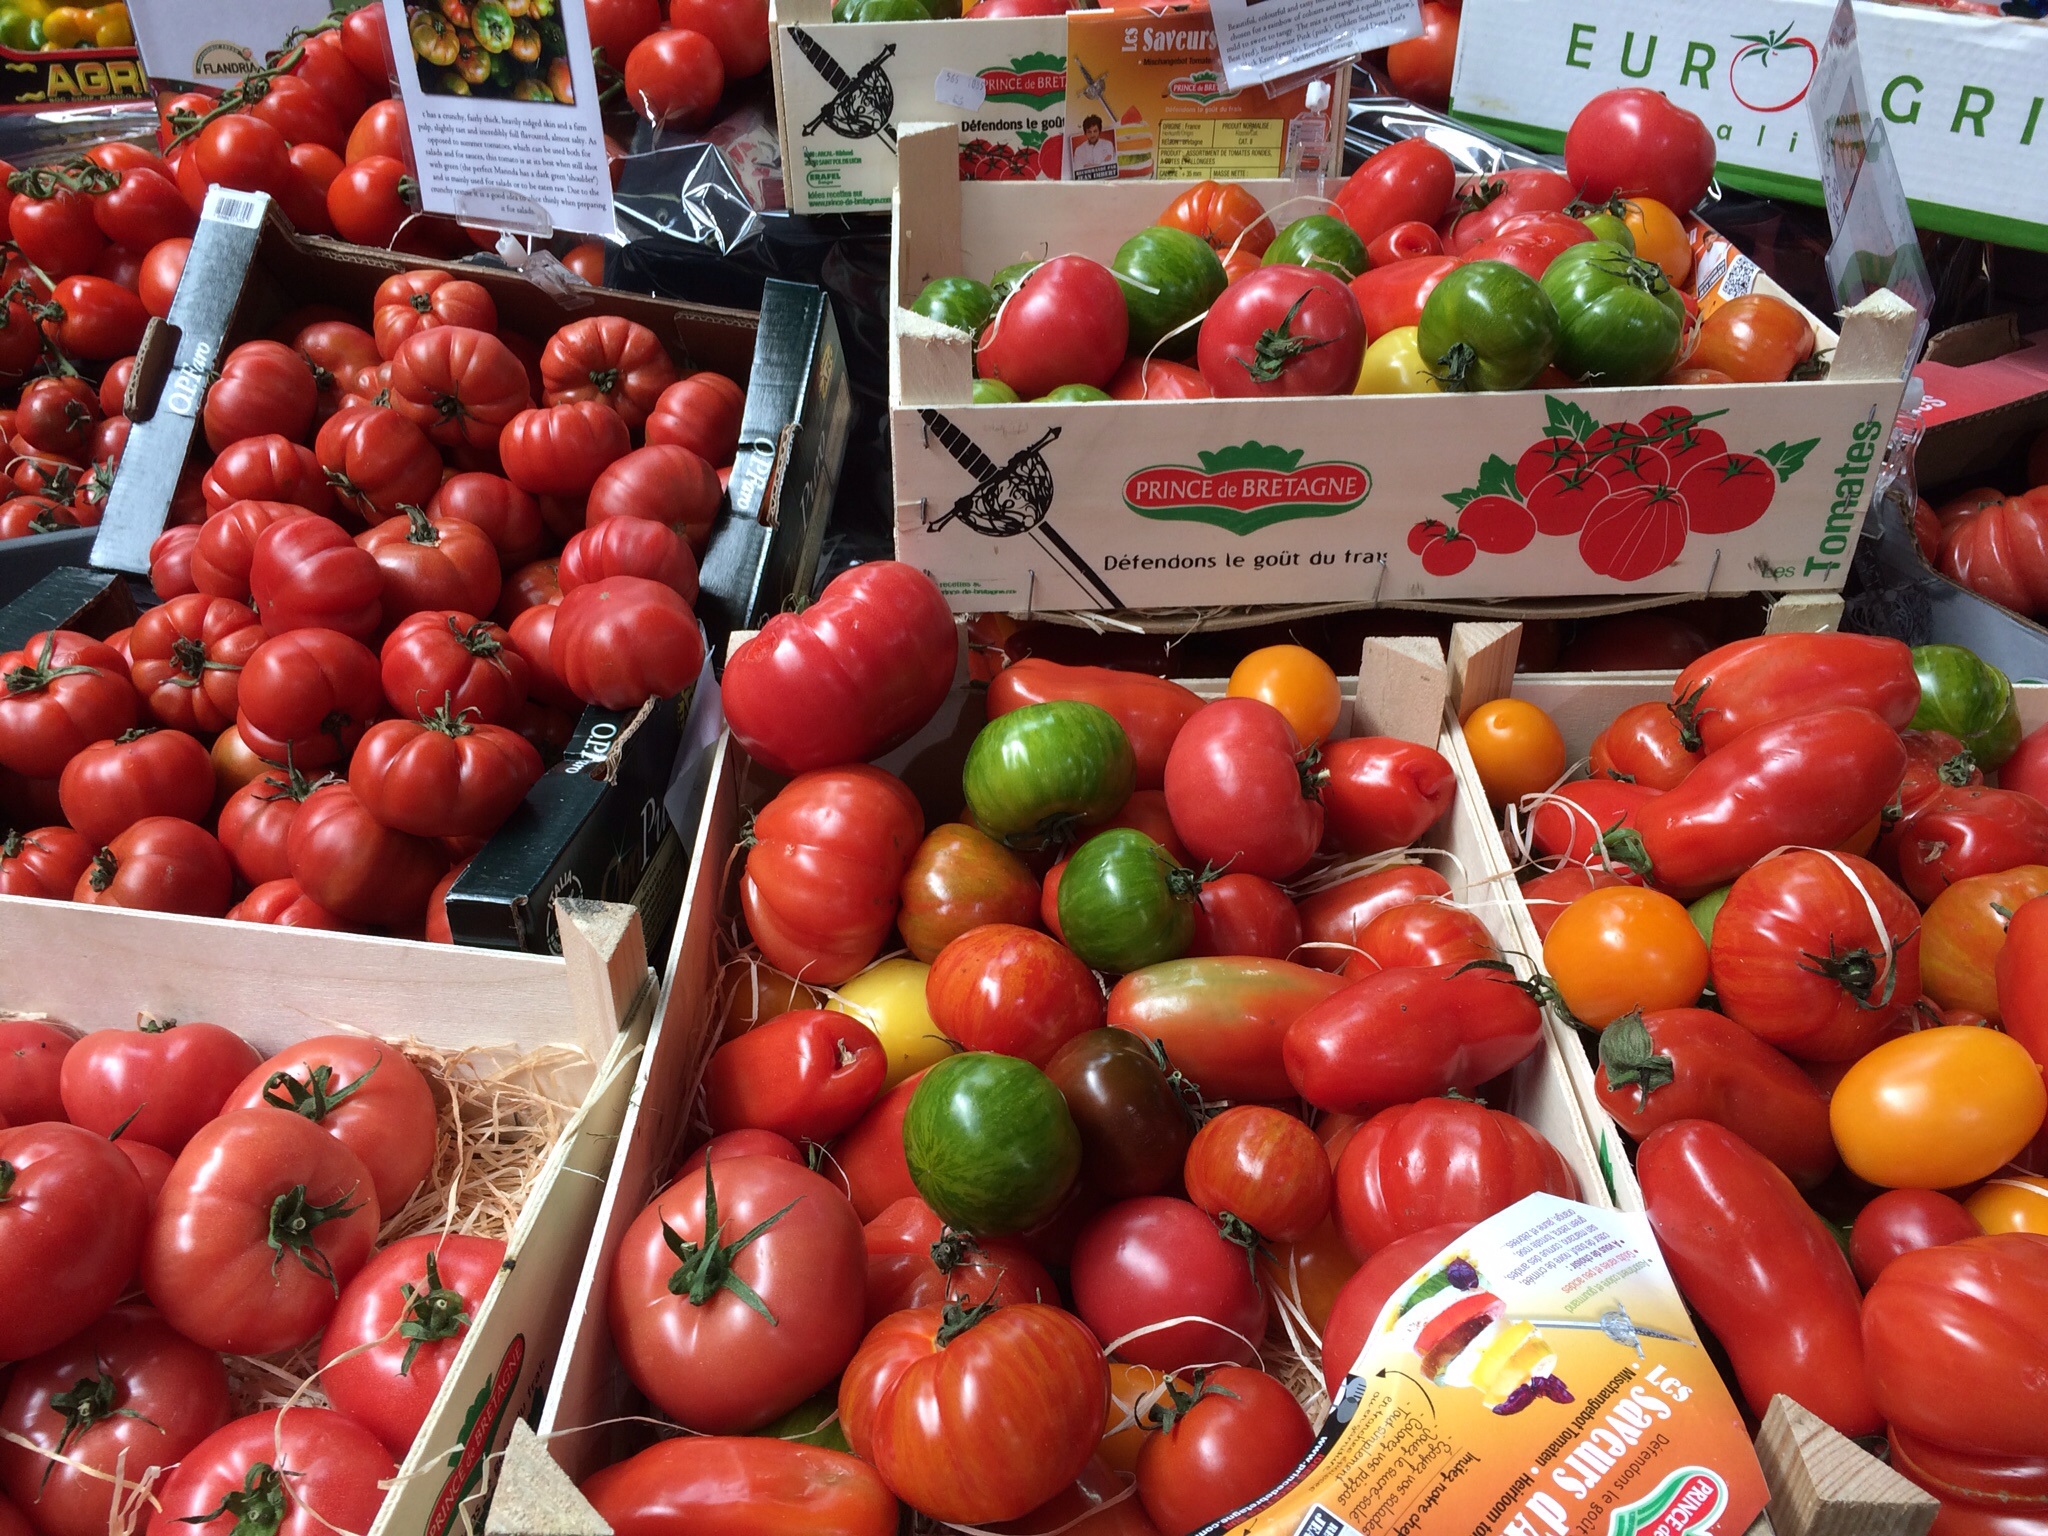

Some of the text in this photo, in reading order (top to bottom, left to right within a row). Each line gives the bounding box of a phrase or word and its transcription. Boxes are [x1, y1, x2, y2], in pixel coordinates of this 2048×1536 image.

[1122, 27, 1217, 52] Les Saveurs
[203, 62, 260, 74] FLANDRIA
[1025, 78, 1037, 90] de
[1038, 75, 1066, 90] BRET
[1174, 84, 1195, 92] PRINCE
[961, 118, 1022, 132] Défendons
[1026, 118, 1038, 129] le
[1136, 476, 1357, 500] PRINCE de BRETAGNE
[1803, 420, 1882, 577] Tomates
[1104, 550, 1335, 571] Défendons le goût du
[1643, 1360, 1694, 1408] Les
[1534, 1361, 1636, 1471] Mischangebot Tomaten
[429, 1469, 466, 1536] PRINCE
[466, 1447, 476, 1467] de
[475, 1343, 523, 1446] BRETAGNE
[1331, 1403, 1411, 1487] Tout simplement
[1331, 1411, 1424, 1508] Colorez vos pizzas
[1398, 1422, 1438, 1463] Jouez
[1548, 1377, 1674, 1511] Saveurs
[1394, 1472, 1417, 1496] vos
[1437, 1445, 1481, 1491] Imitez
[1575, 1433, 1670, 1536] Défendons le goût
[1346, 1466, 1401, 1526] sucré-salé
[1359, 1491, 1405, 1536] salades
[1415, 1481, 1450, 1518] notre
[1486, 1473, 1535, 1523] Heirloom
[1672, 1479, 1714, 1532] PRINCE
